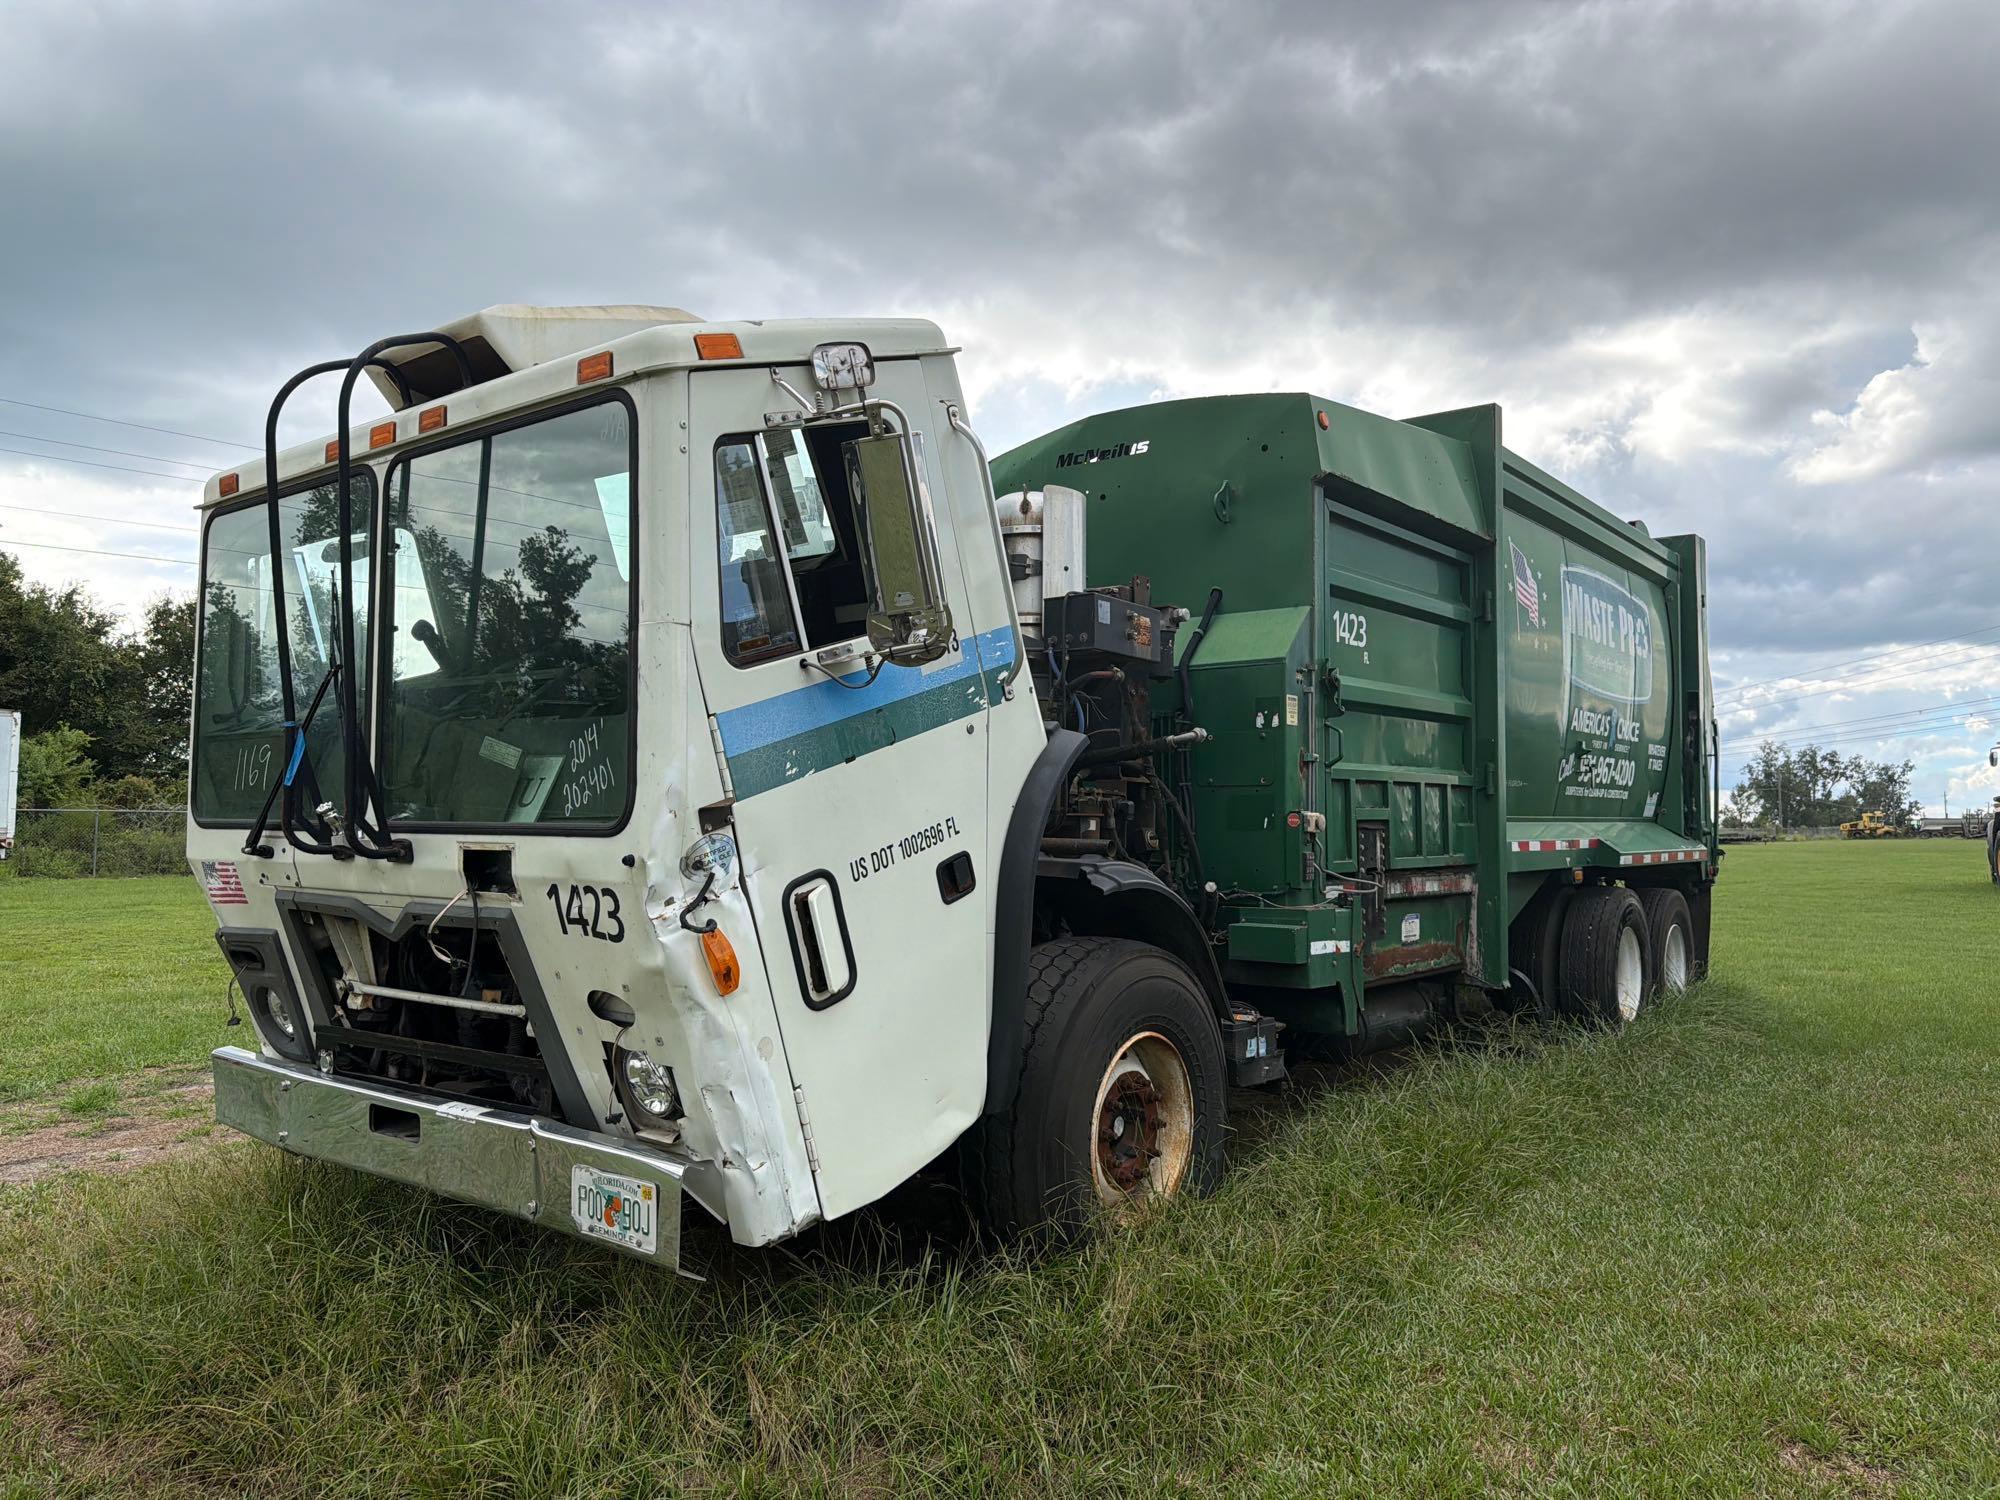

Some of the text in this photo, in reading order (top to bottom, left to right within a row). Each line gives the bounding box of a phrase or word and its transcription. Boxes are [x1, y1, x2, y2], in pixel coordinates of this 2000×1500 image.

[1333, 610, 1367, 648] 1423
[1565, 580, 1615, 648] WASTE
[1571, 707, 1611, 737] AMERICA'S
[234, 743, 272, 792] 1169
[563, 757, 615, 817] 202401
[849, 816, 961, 882] US DOT 1002696 FL
[546, 883, 626, 944] 1423
